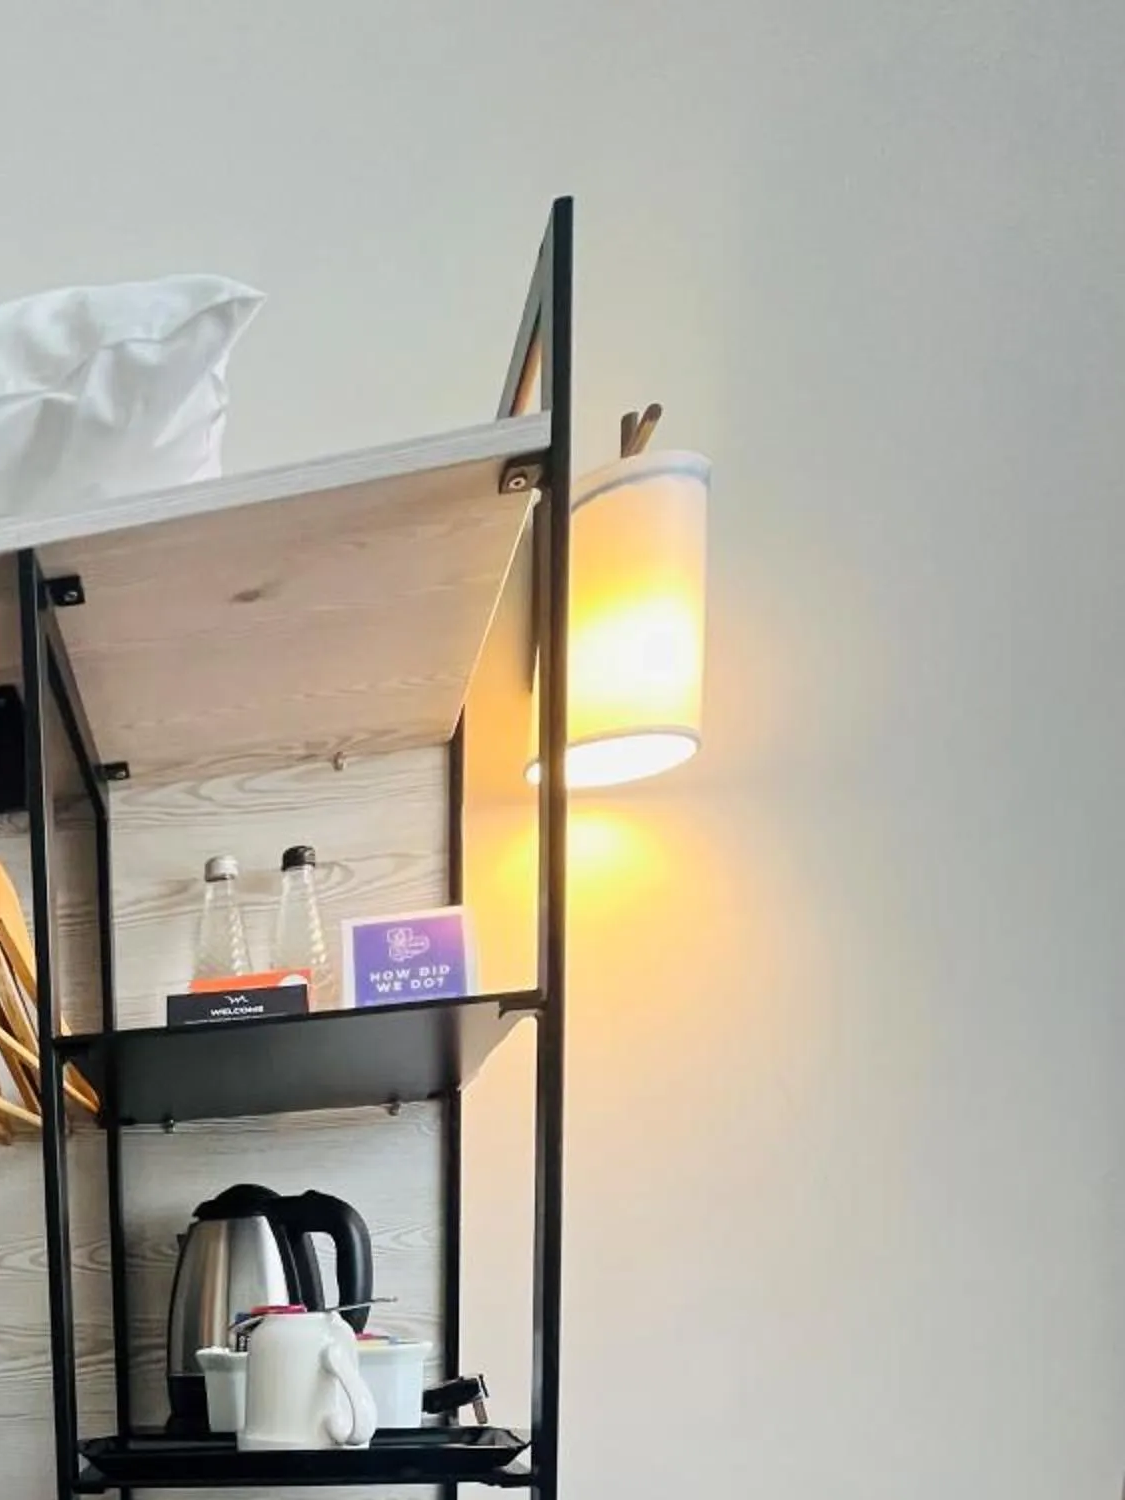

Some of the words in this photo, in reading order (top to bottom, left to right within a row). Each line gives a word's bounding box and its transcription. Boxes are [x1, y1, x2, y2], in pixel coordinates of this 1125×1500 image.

[369, 968, 411, 983] HOW
[418, 964, 451, 977] DID
[376, 981, 403, 993] WE
[410, 977, 445, 989] DO?
[210, 1005, 264, 1017] WELCOME
